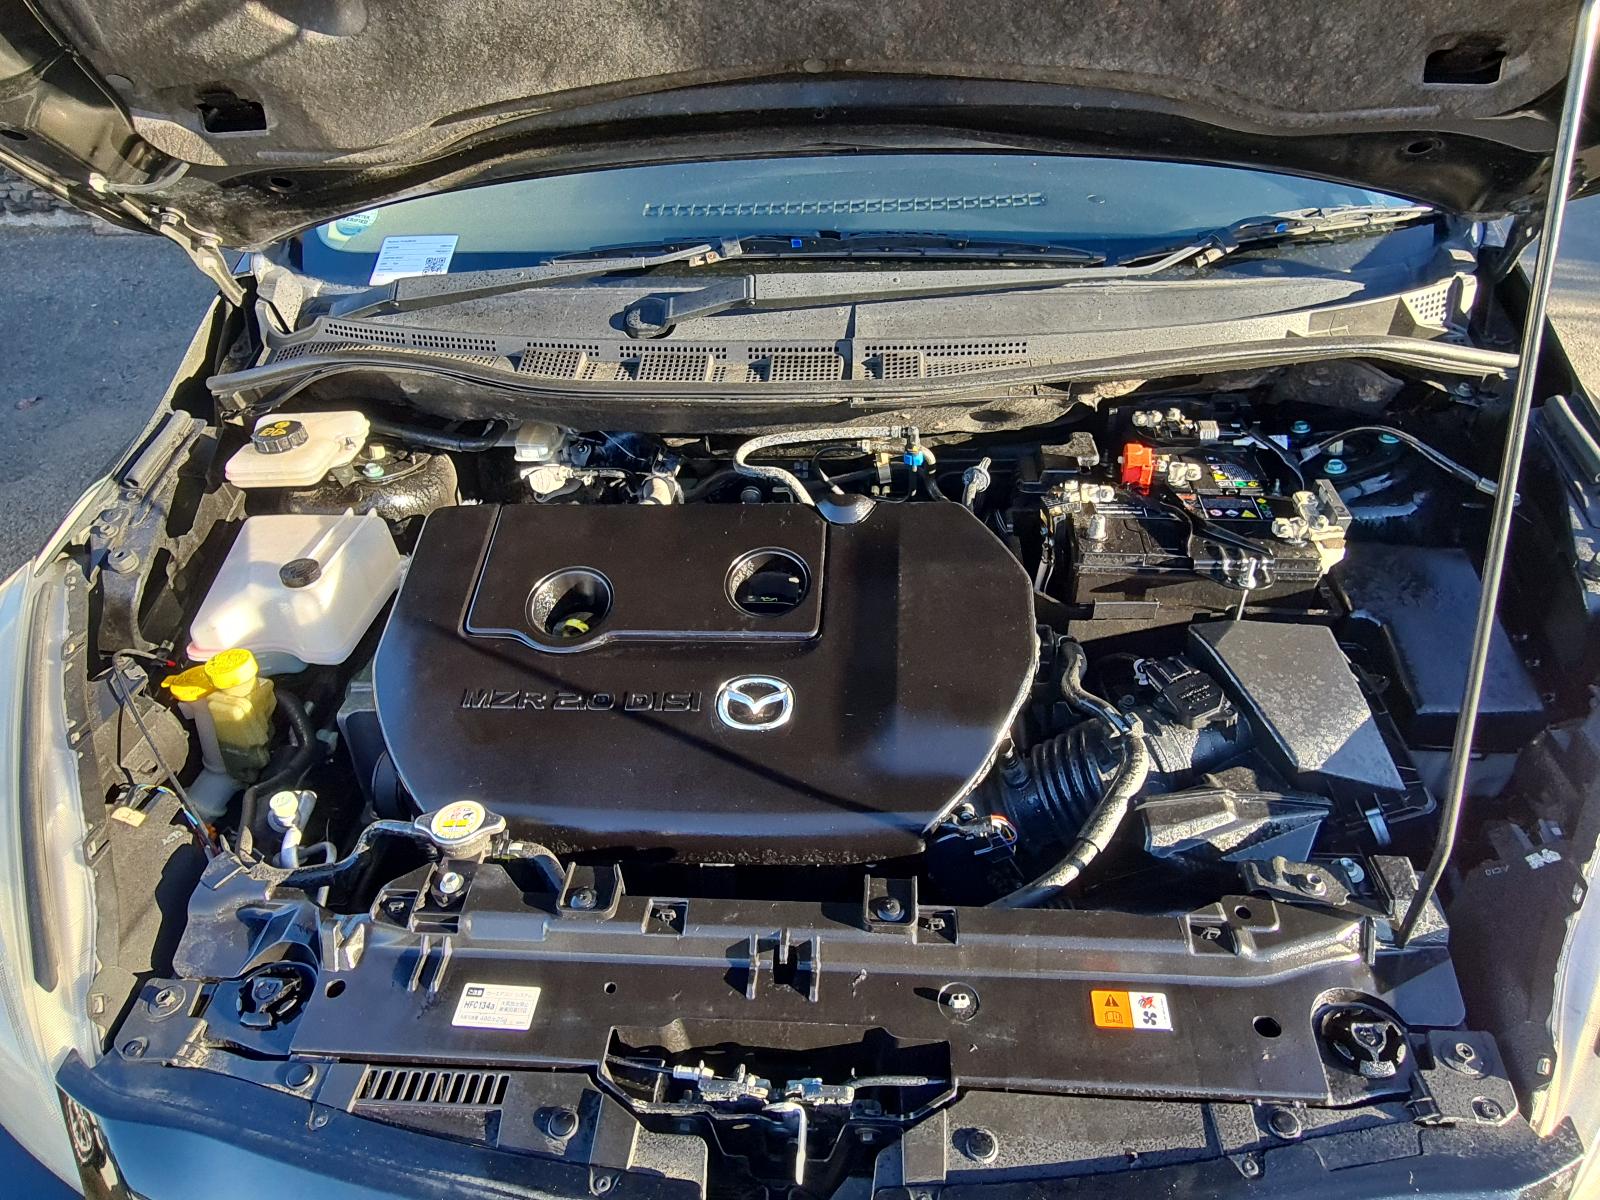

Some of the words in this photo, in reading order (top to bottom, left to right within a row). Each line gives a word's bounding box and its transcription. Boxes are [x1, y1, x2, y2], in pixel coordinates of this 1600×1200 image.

[462, 690, 547, 710] MZR
[553, 692, 616, 711] 2.0
[624, 691, 703, 712] DISI
[463, 1000, 496, 1010] HFC134a
